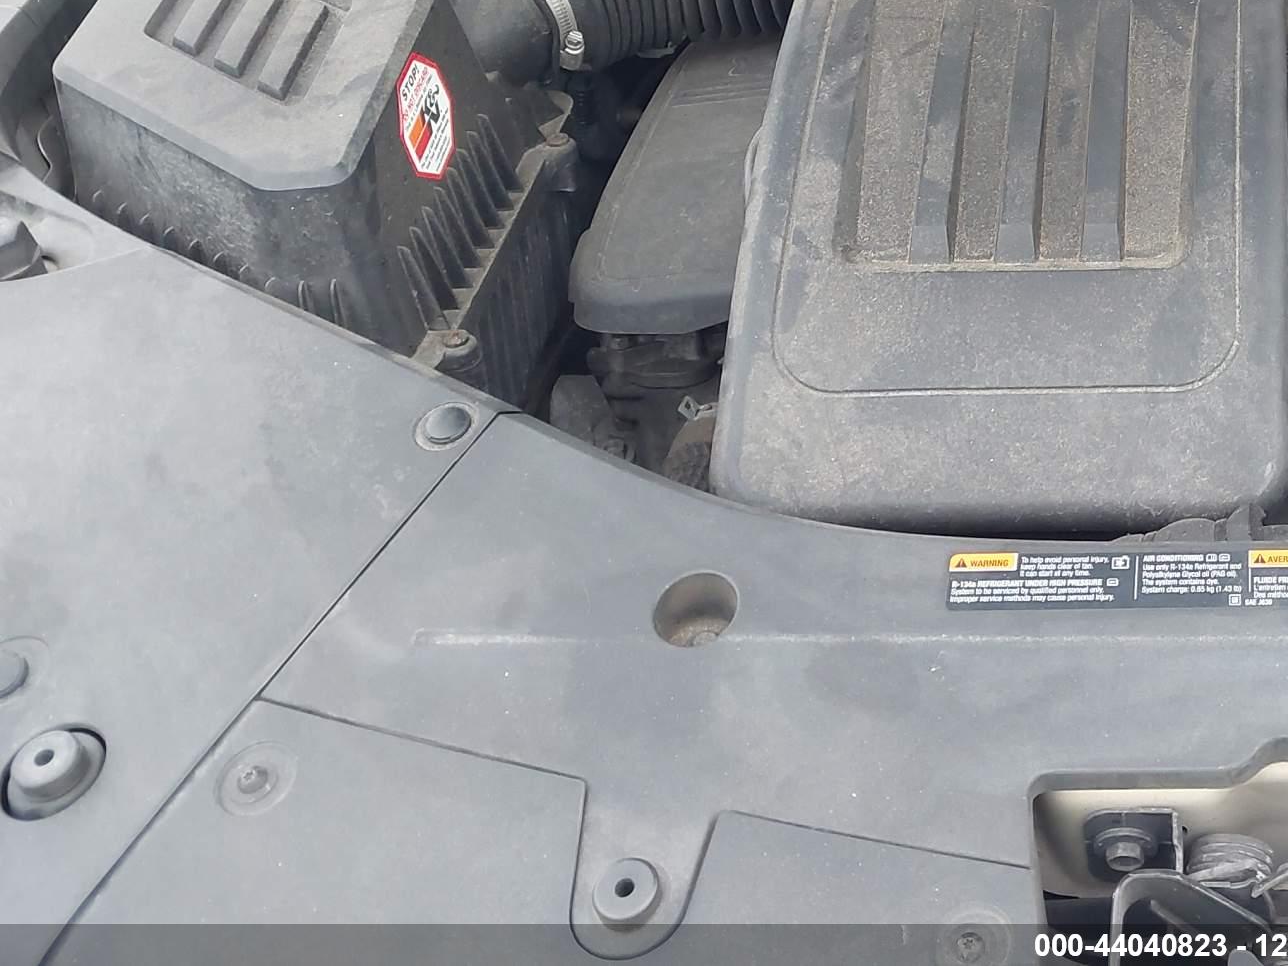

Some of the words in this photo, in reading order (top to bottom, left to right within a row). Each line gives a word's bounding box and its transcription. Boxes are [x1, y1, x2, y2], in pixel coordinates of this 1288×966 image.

[401, 64, 420, 101] STOP!
[970, 559, 1009, 567] WARNING
[1062, 556, 1090, 564] personal
[1142, 563, 1155, 571] Use
[1155, 563, 1169, 571] only
[951, 588, 975, 596] System
[1020, 587, 1029, 595] by
[1141, 586, 1165, 594] System
[1047, 594, 1066, 602] cause
